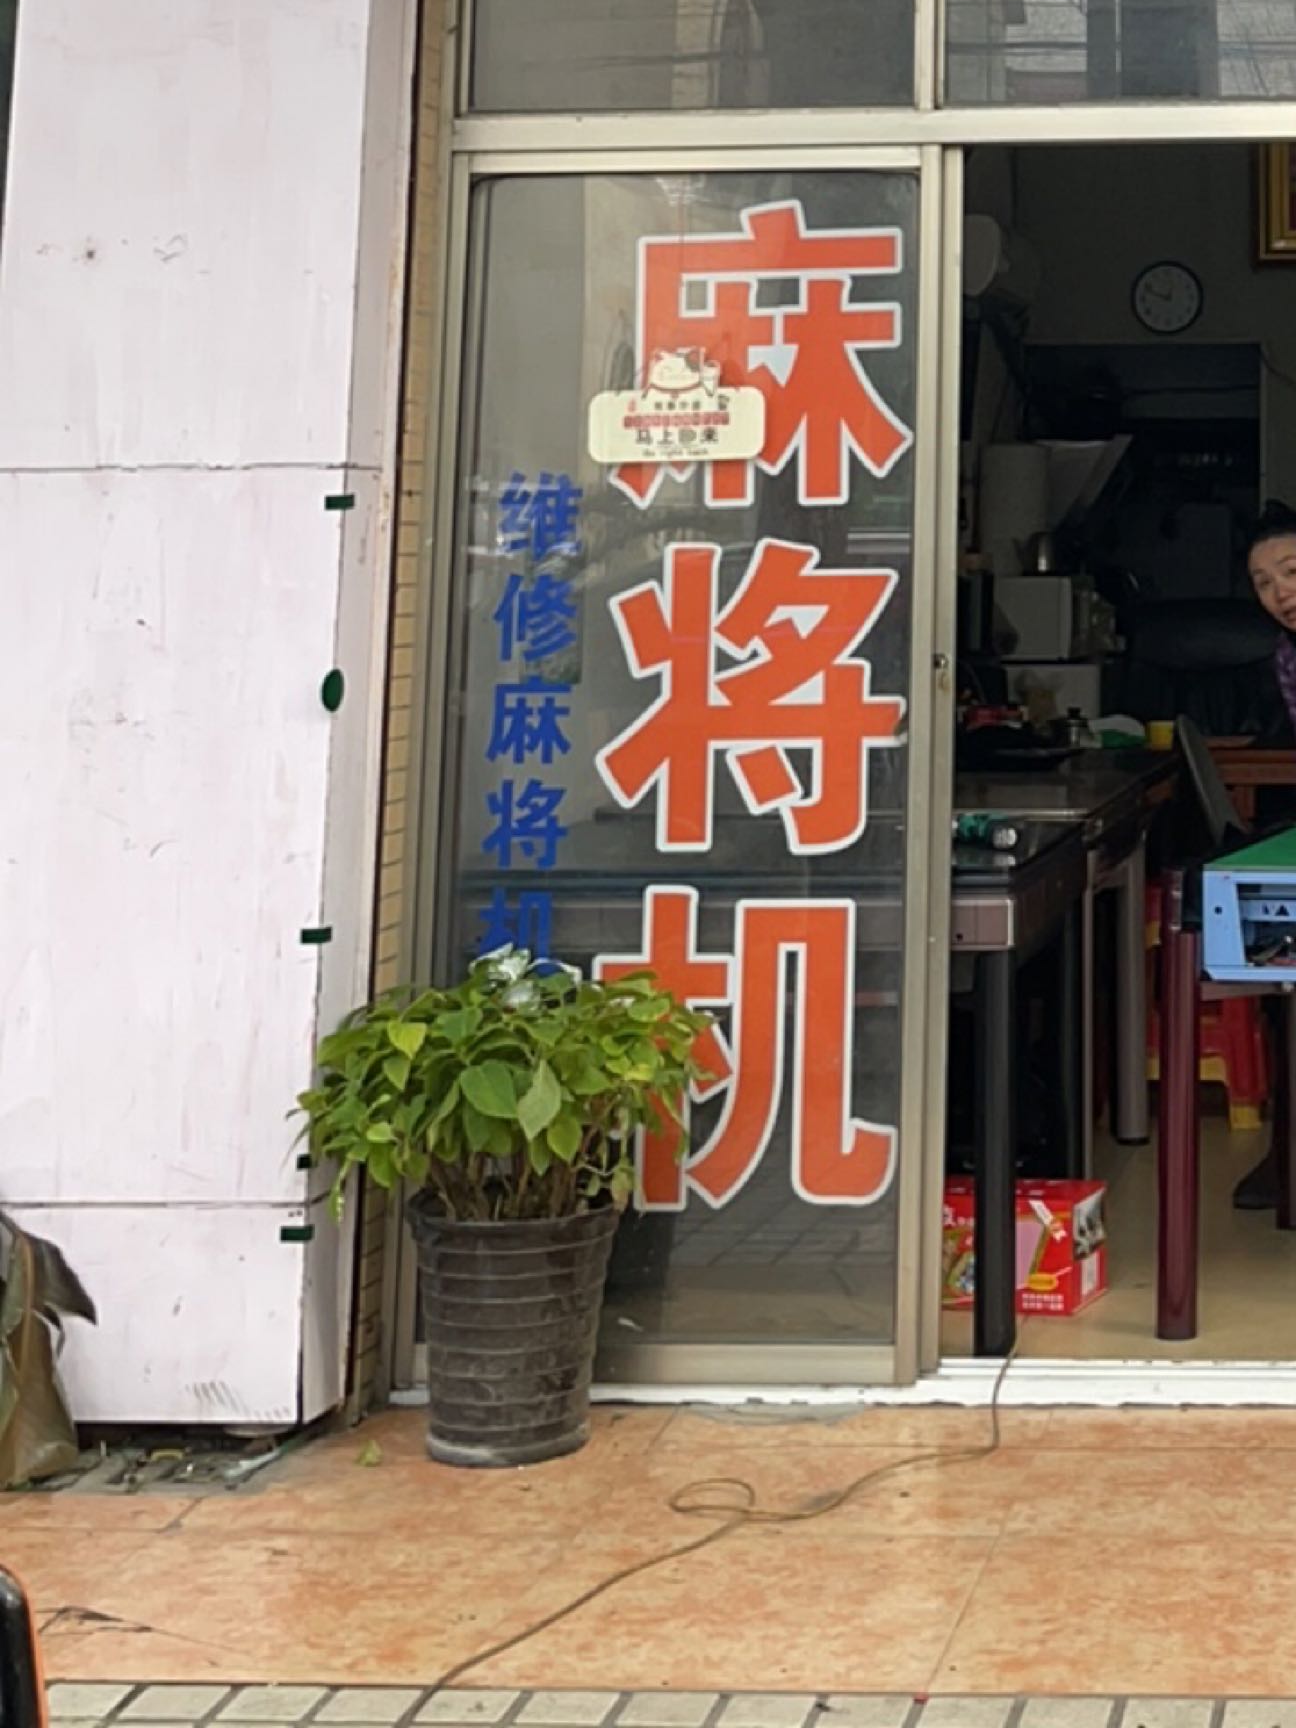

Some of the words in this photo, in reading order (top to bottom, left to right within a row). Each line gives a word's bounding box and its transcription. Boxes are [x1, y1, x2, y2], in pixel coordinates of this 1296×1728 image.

[476, 470, 583, 978] 维修麻将机
[594, 199, 914, 1214] 麻将机
